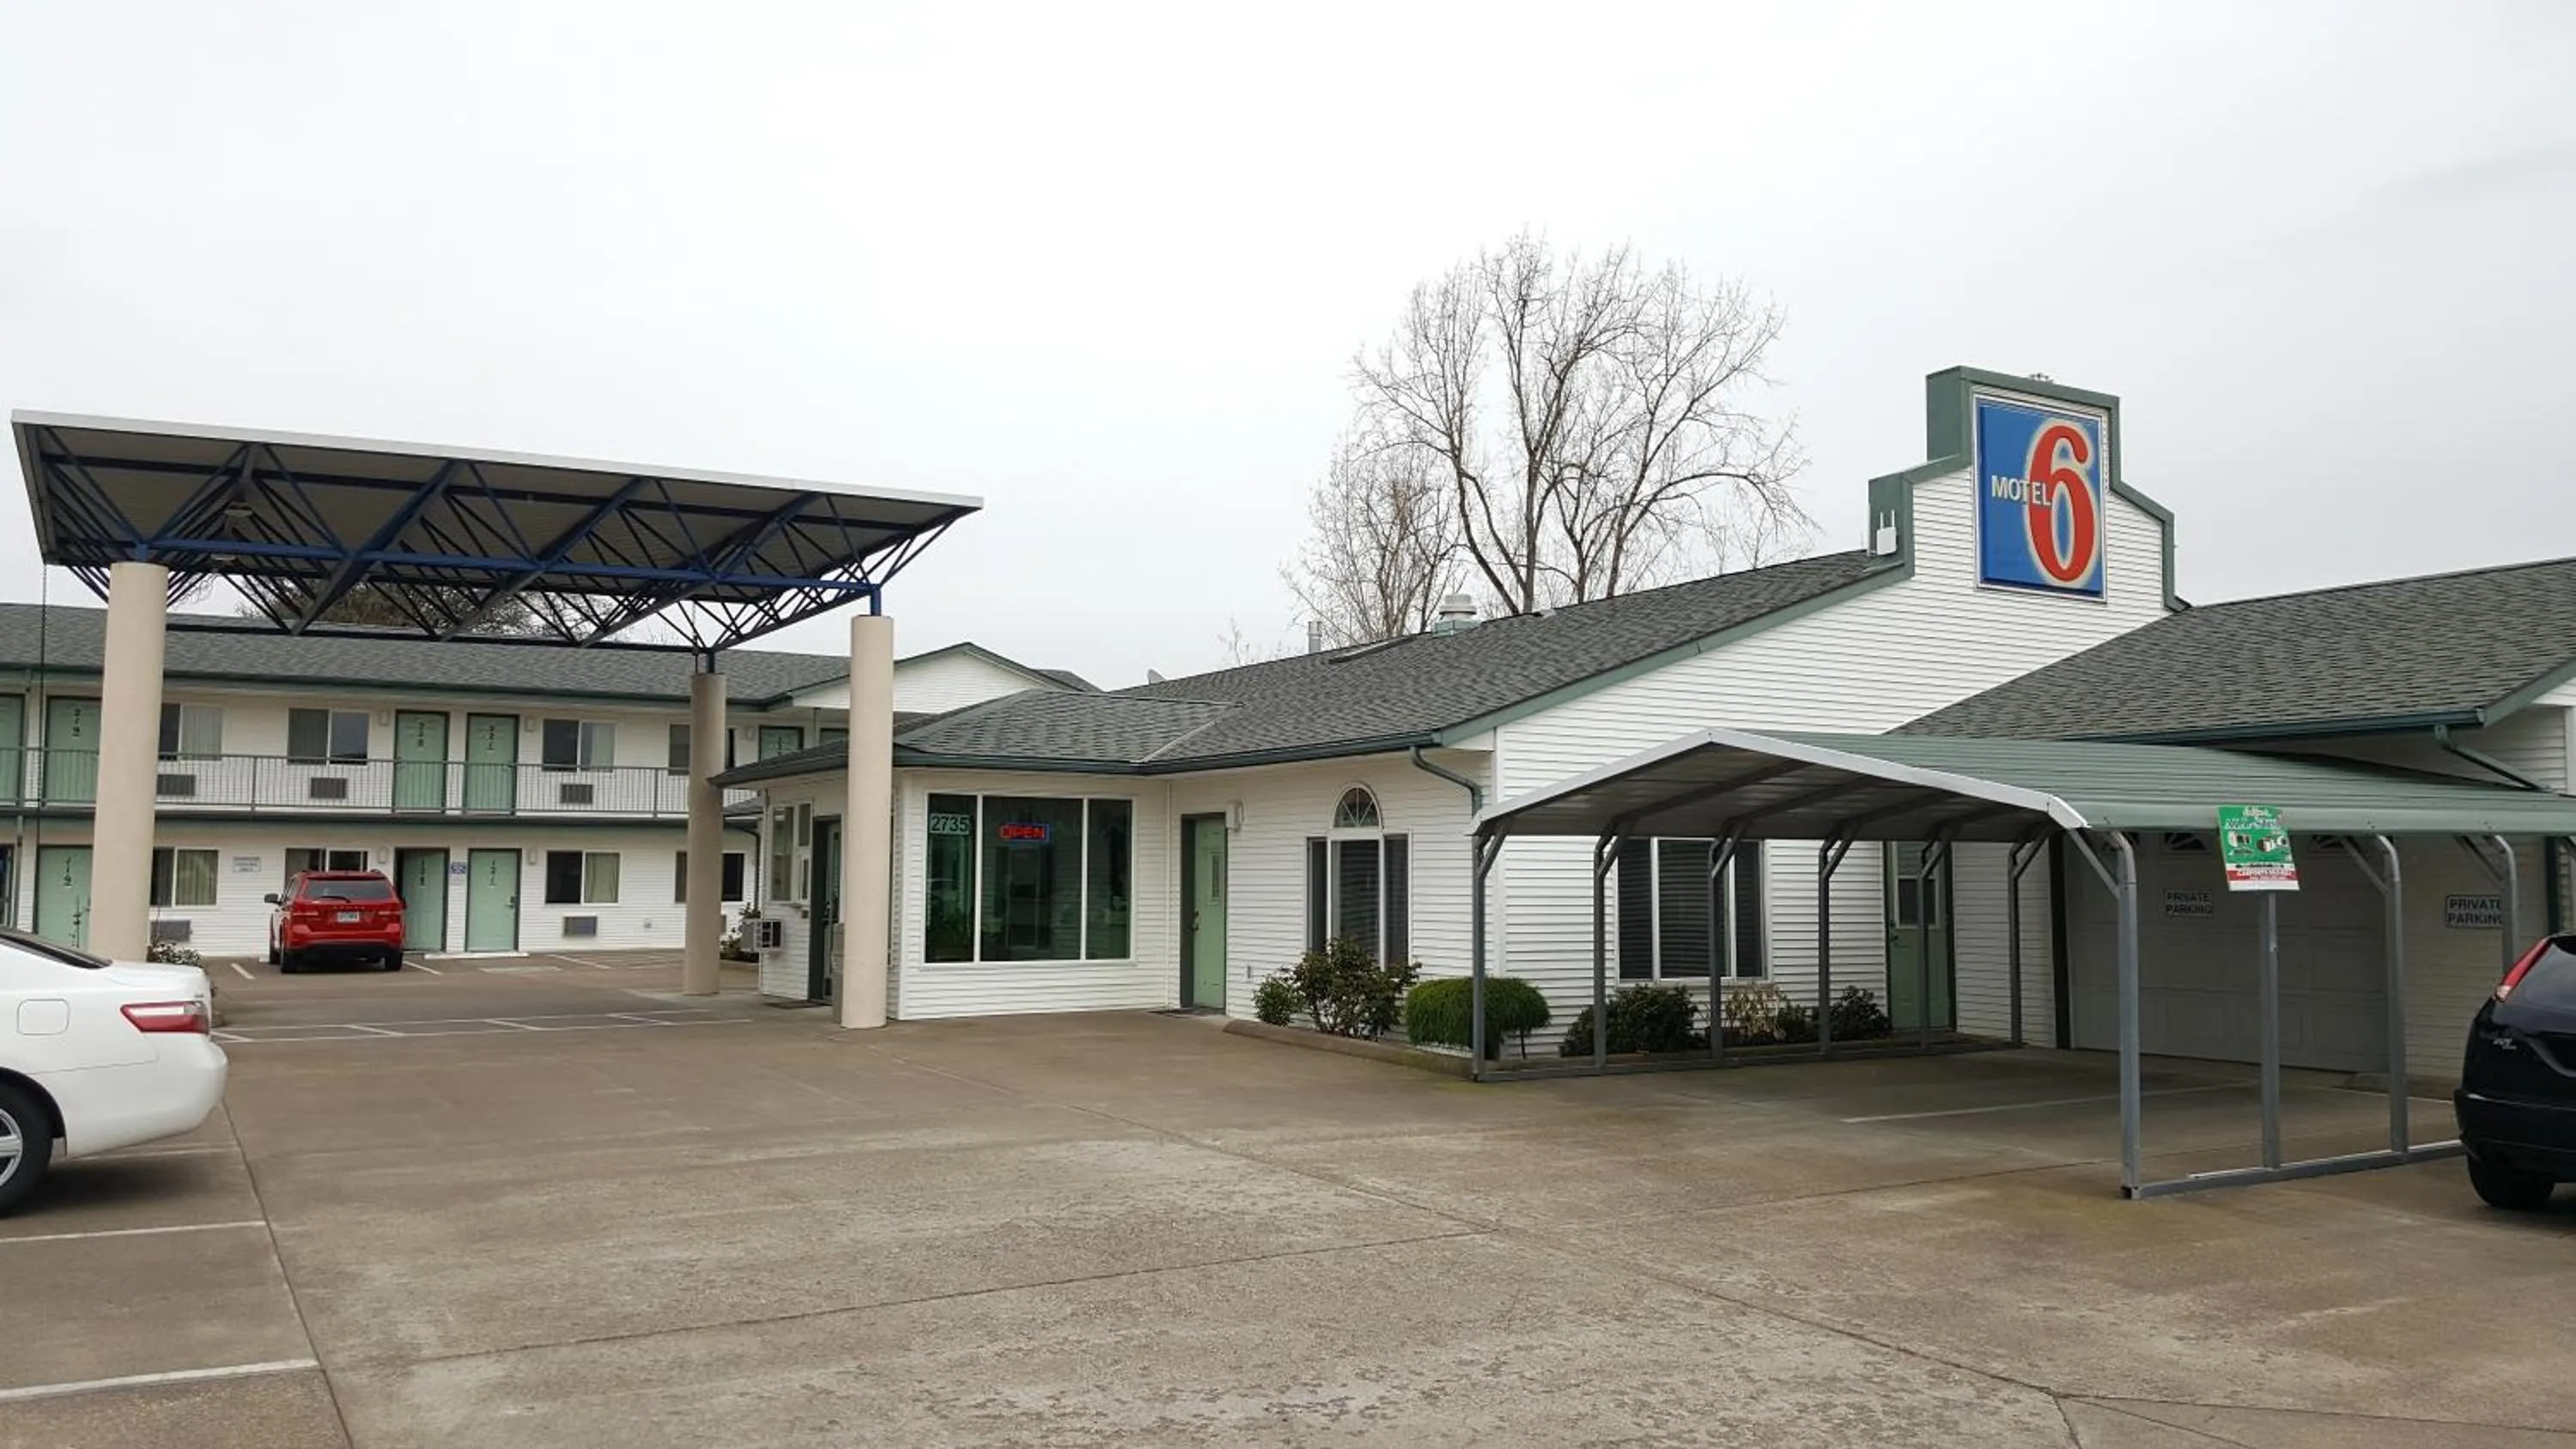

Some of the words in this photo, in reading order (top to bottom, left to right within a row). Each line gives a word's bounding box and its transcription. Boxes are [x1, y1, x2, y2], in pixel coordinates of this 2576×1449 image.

[1990, 475, 2052, 506] MOTEL
[2028, 424, 2095, 583] 6
[932, 816, 969, 832] 2735
[1000, 825, 1046, 839] OPEN
[2166, 892, 2210, 902] PRIVATE
[2166, 904, 2212, 914] PARKING
